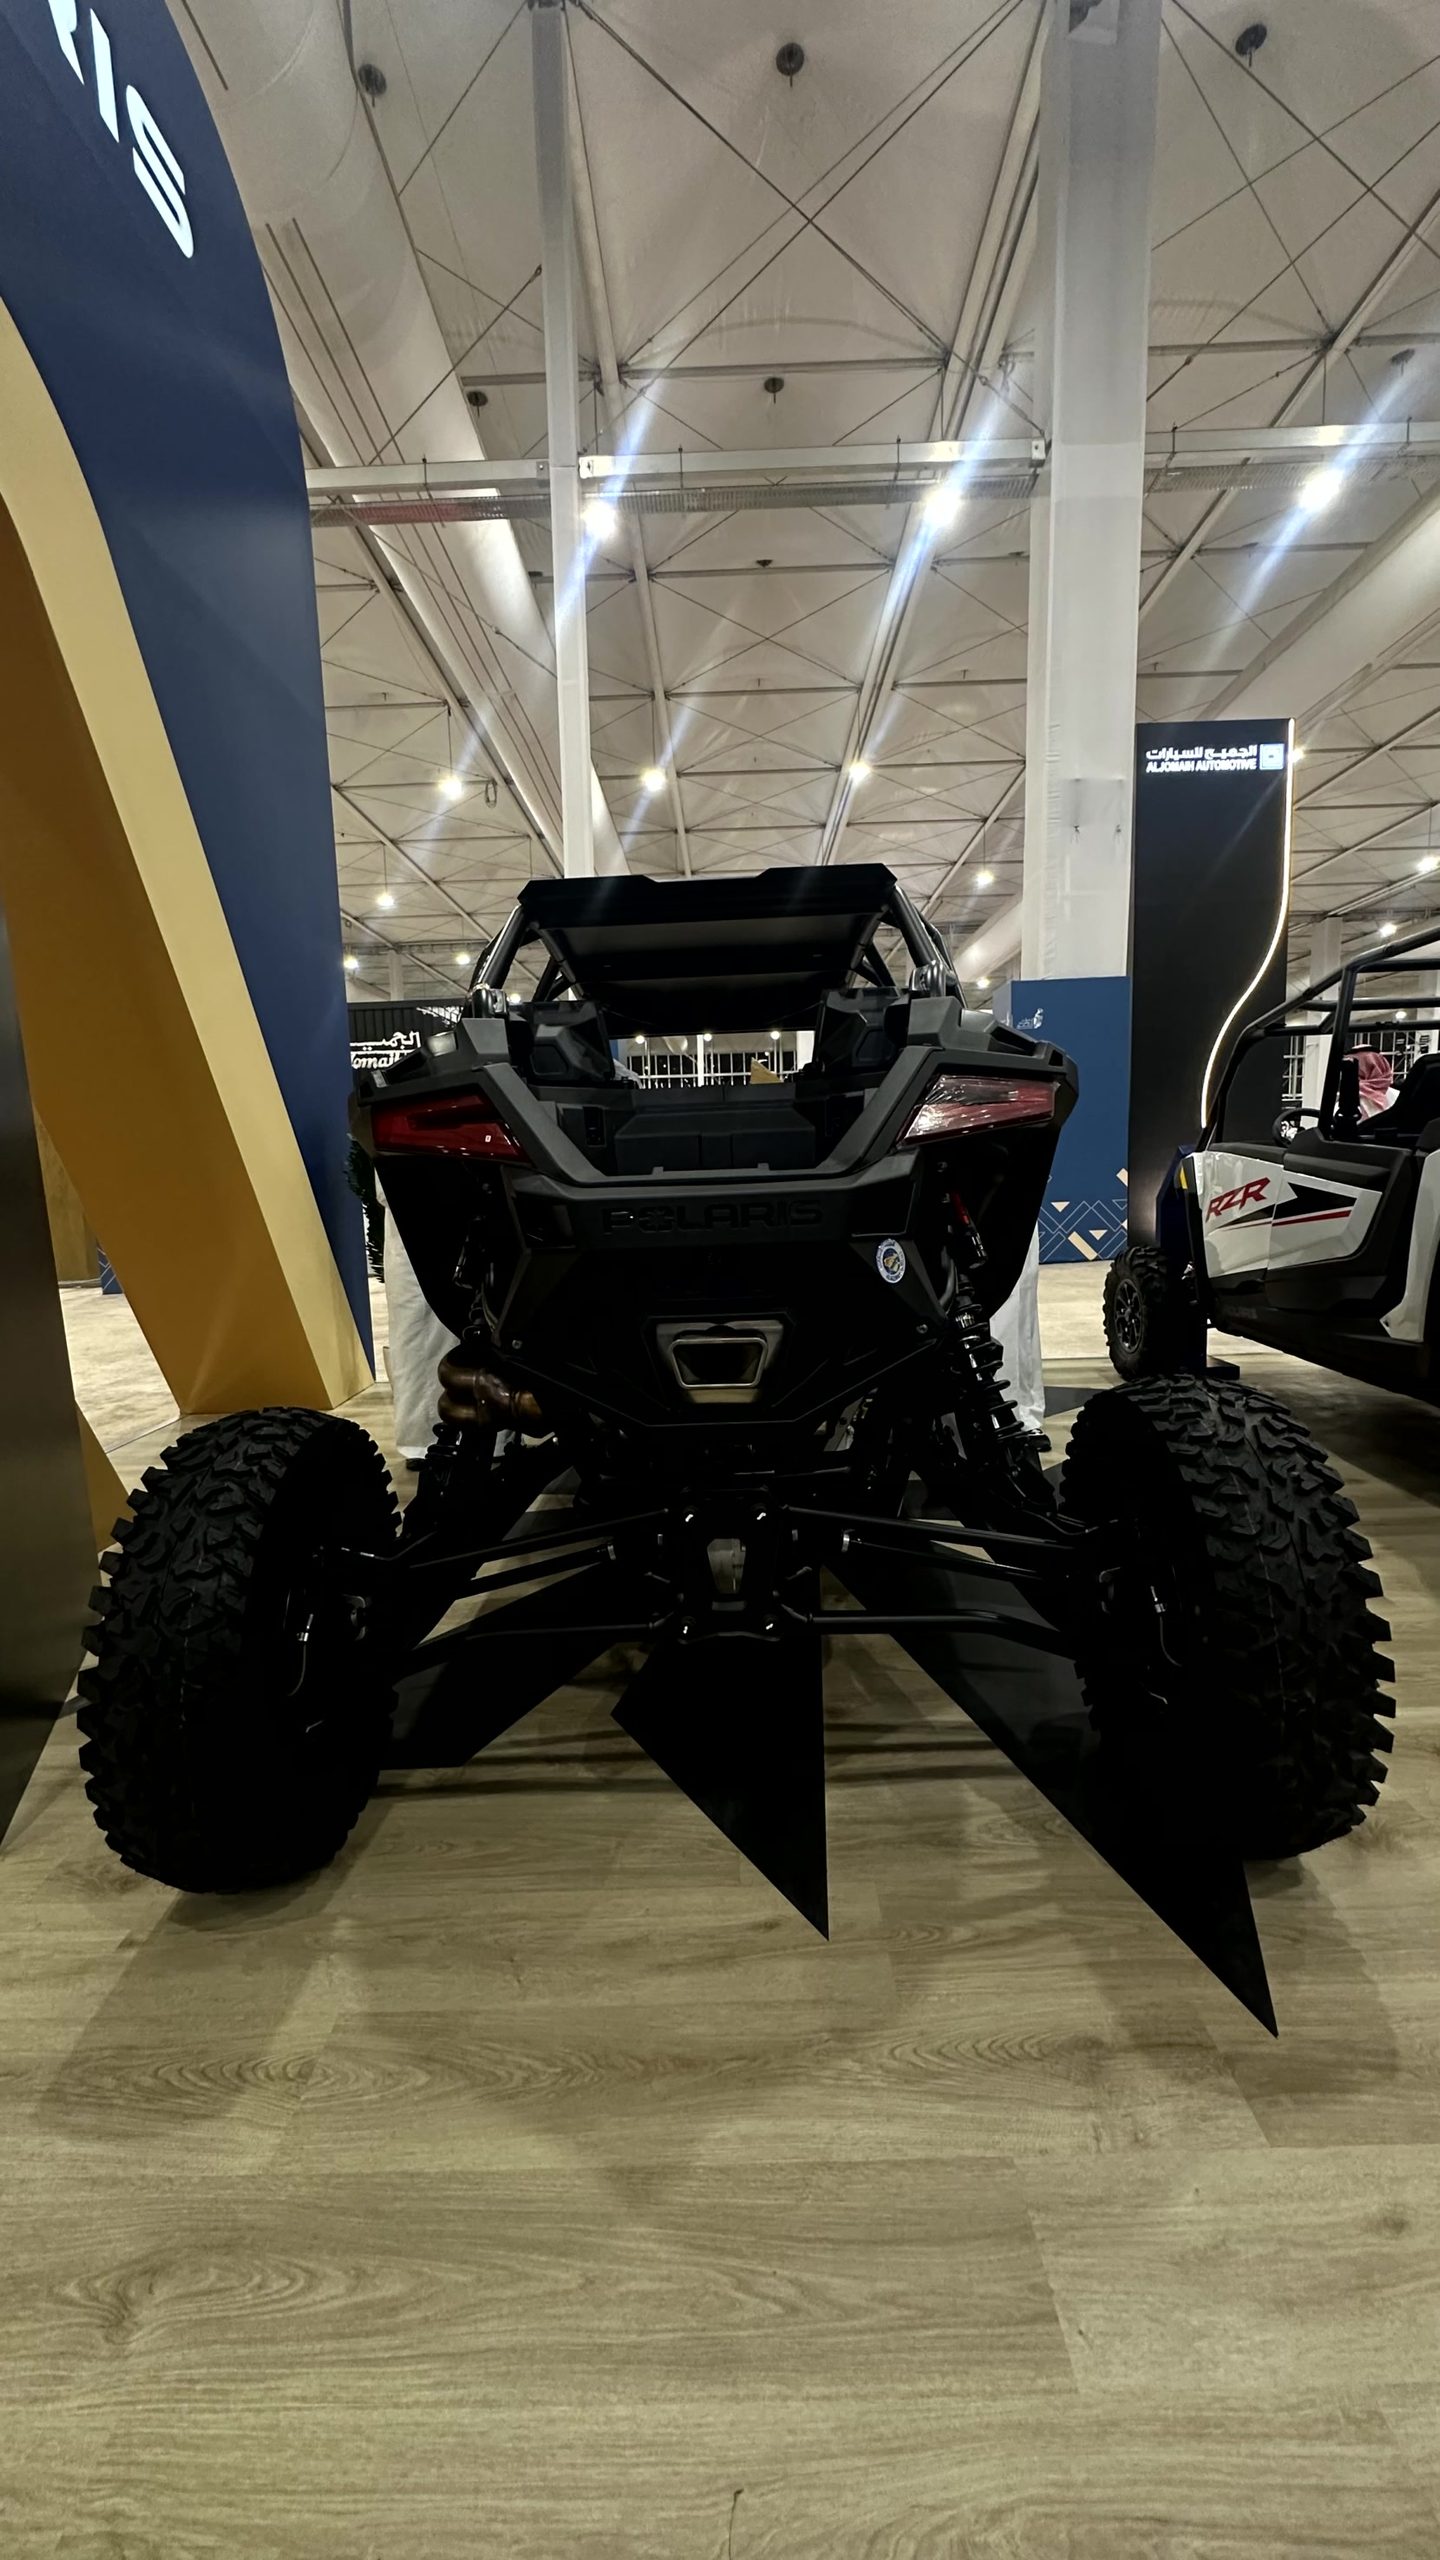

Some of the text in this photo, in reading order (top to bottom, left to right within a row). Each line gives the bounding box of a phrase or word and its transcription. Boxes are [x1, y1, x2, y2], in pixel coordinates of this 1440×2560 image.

[1195, 758, 1257, 771] AUTOMOTIVE
[1206, 1177, 1270, 1222] RZR
[602, 1200, 823, 1237] POLARIS
